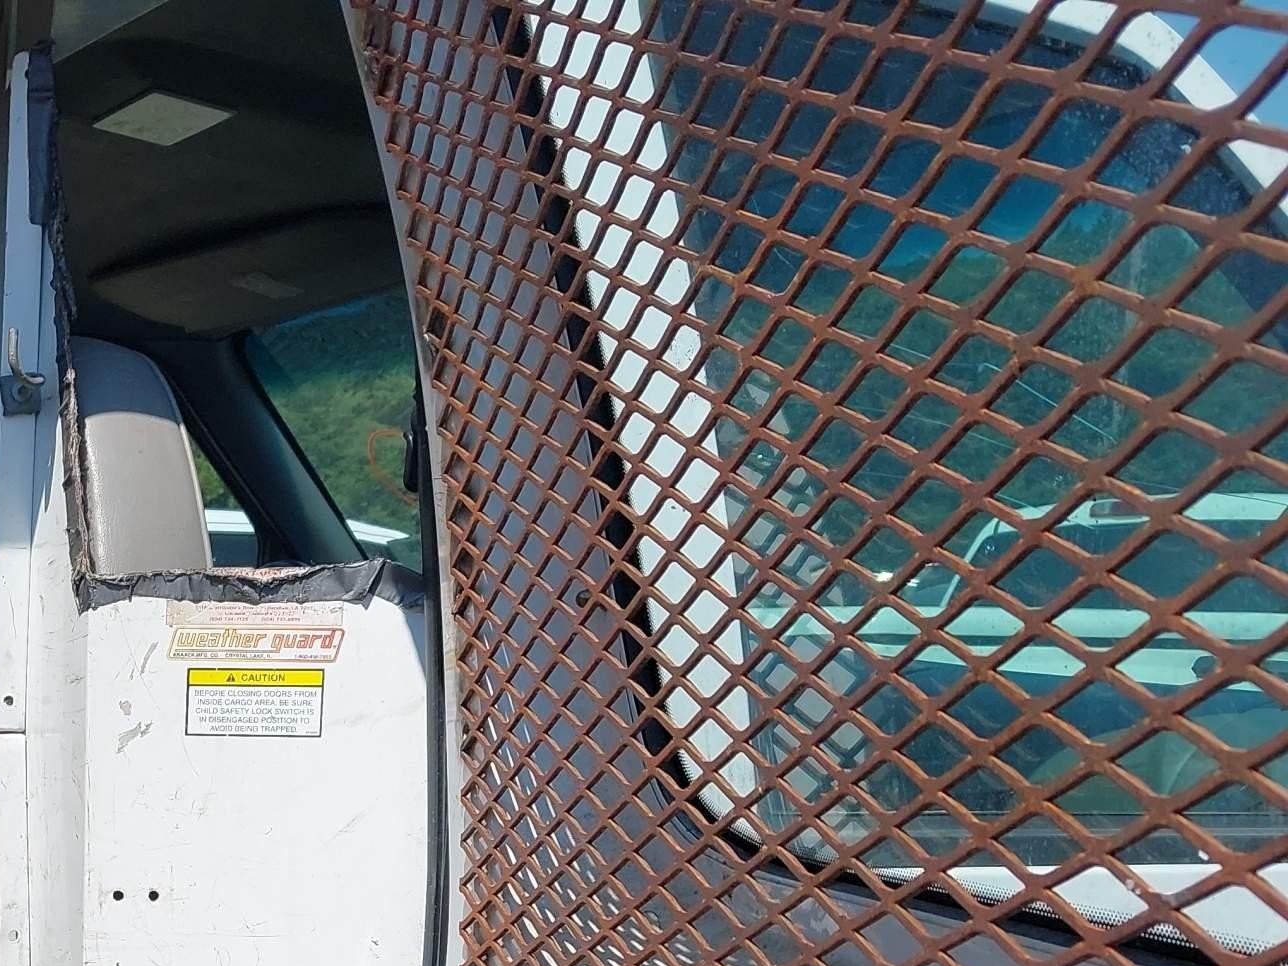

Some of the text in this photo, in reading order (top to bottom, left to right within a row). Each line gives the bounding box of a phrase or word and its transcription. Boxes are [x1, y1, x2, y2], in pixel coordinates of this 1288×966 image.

[177, 629, 336, 653] weather guard
[241, 673, 286, 682] CAUTION
[228, 690, 261, 698] CLOSING
[264, 690, 292, 698] DOORS
